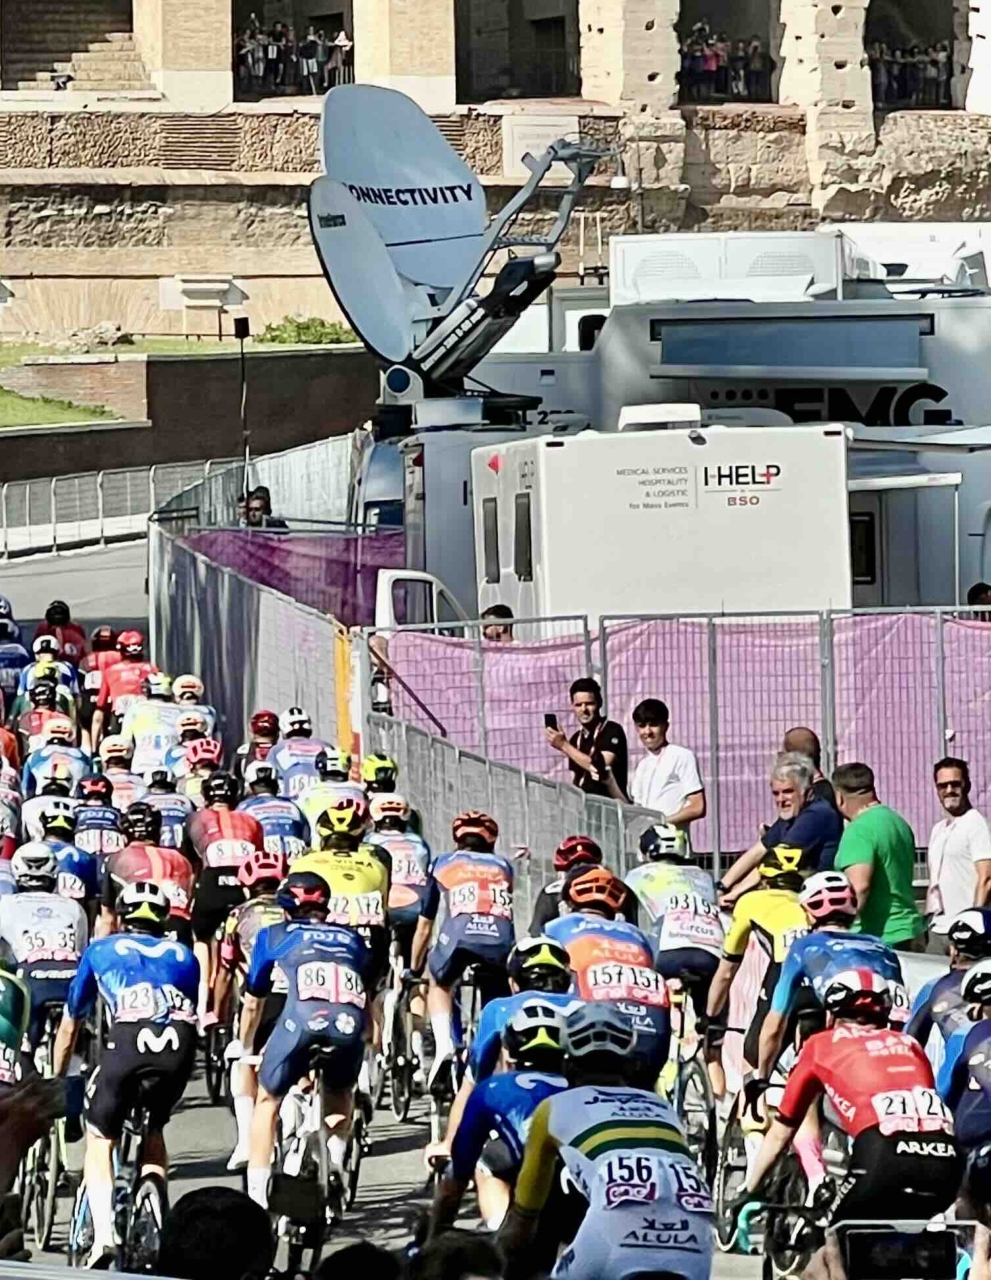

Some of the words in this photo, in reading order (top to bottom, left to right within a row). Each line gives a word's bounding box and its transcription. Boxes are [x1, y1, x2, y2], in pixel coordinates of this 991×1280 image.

[343, 183, 473, 207] ONNECTIVITY
[616, 467, 650, 477] MEDICAL
[652, 466, 689, 475] SERVICES
[638, 478, 689, 487] HOSPITALITY
[653, 489, 689, 498] LOGISTIC
[727, 496, 761, 507] BSO
[451, 886, 476, 906] 158
[25, 931, 45, 952] 35
[304, 966, 326, 987] 86
[592, 964, 624, 987] 157
[121, 987, 150, 1009] 123
[896, 1140, 956, 1158] ARKEA
[606, 1156, 653, 1186] 156
[624, 1230, 700, 1245] ALULA
